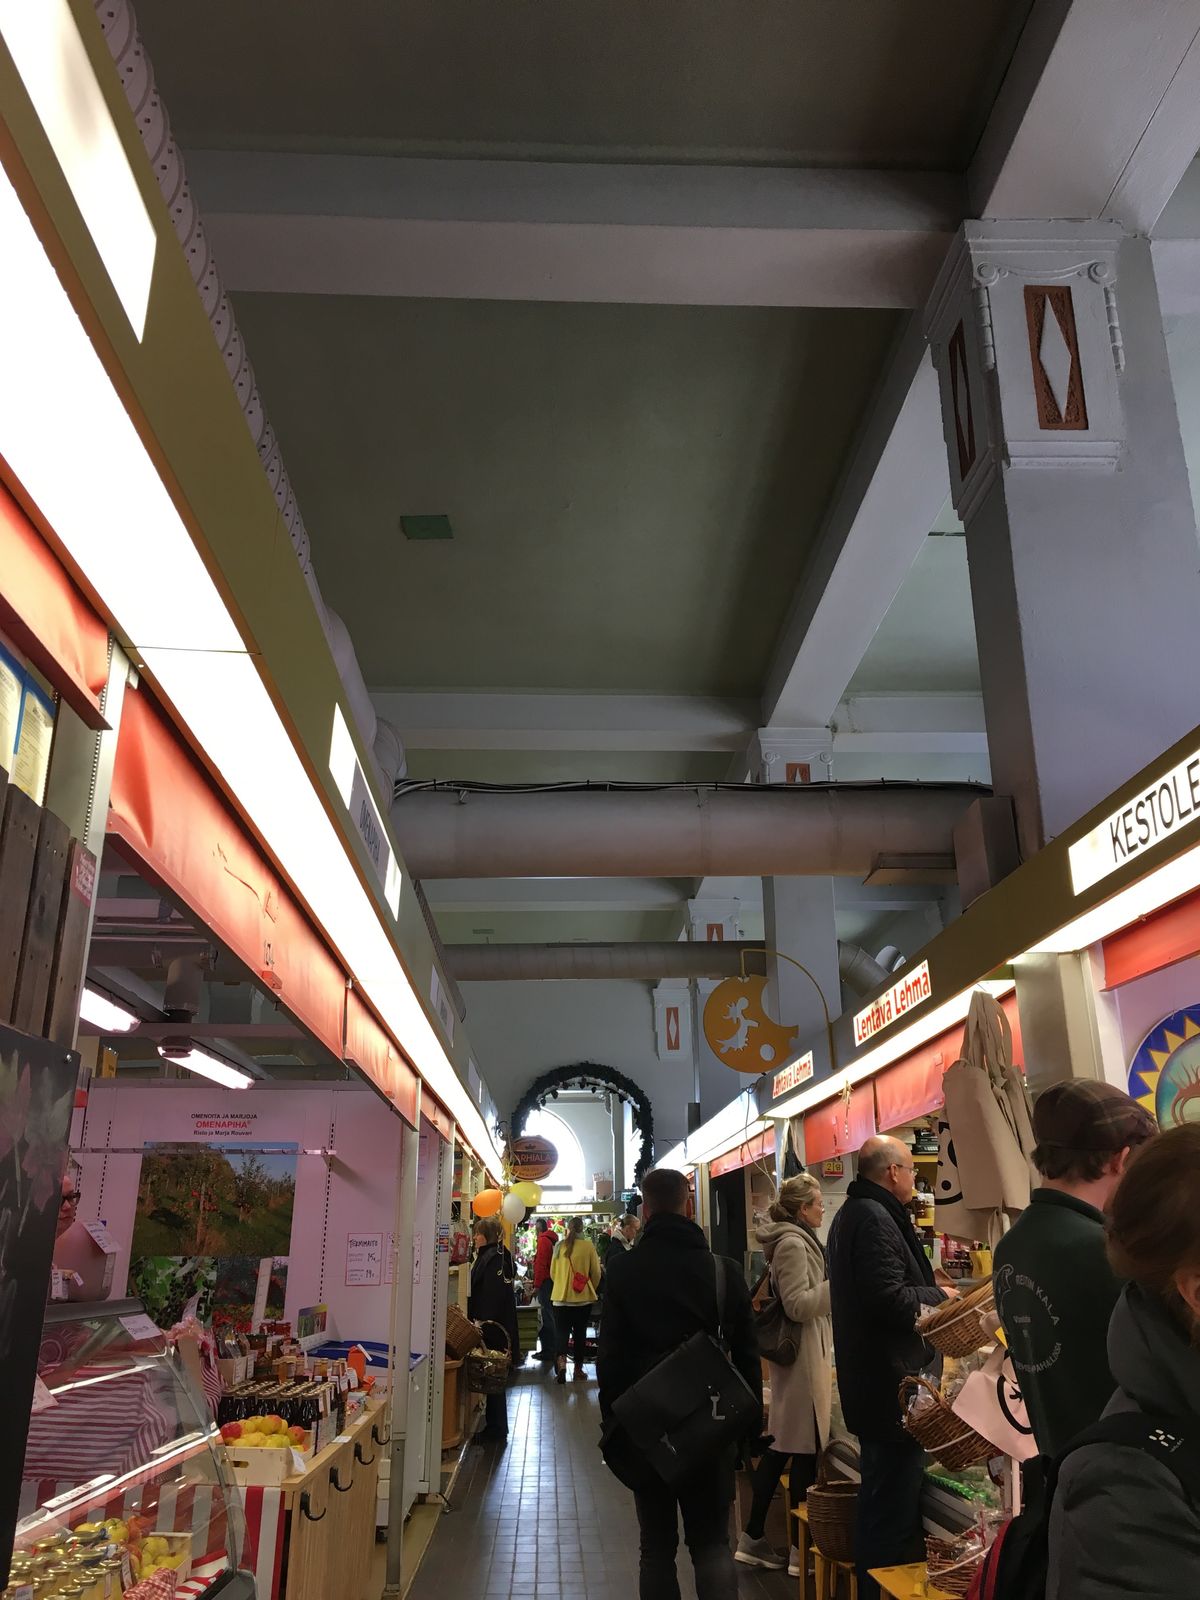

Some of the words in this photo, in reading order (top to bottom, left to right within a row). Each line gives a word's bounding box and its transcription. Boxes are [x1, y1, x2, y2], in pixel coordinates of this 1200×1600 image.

[1109, 758, 1200, 863] KESTOLE
[857, 992, 893, 1041] Lentävä
[893, 963, 930, 1015] Lehmä
[1036, 1286, 1060, 1326] KALA
